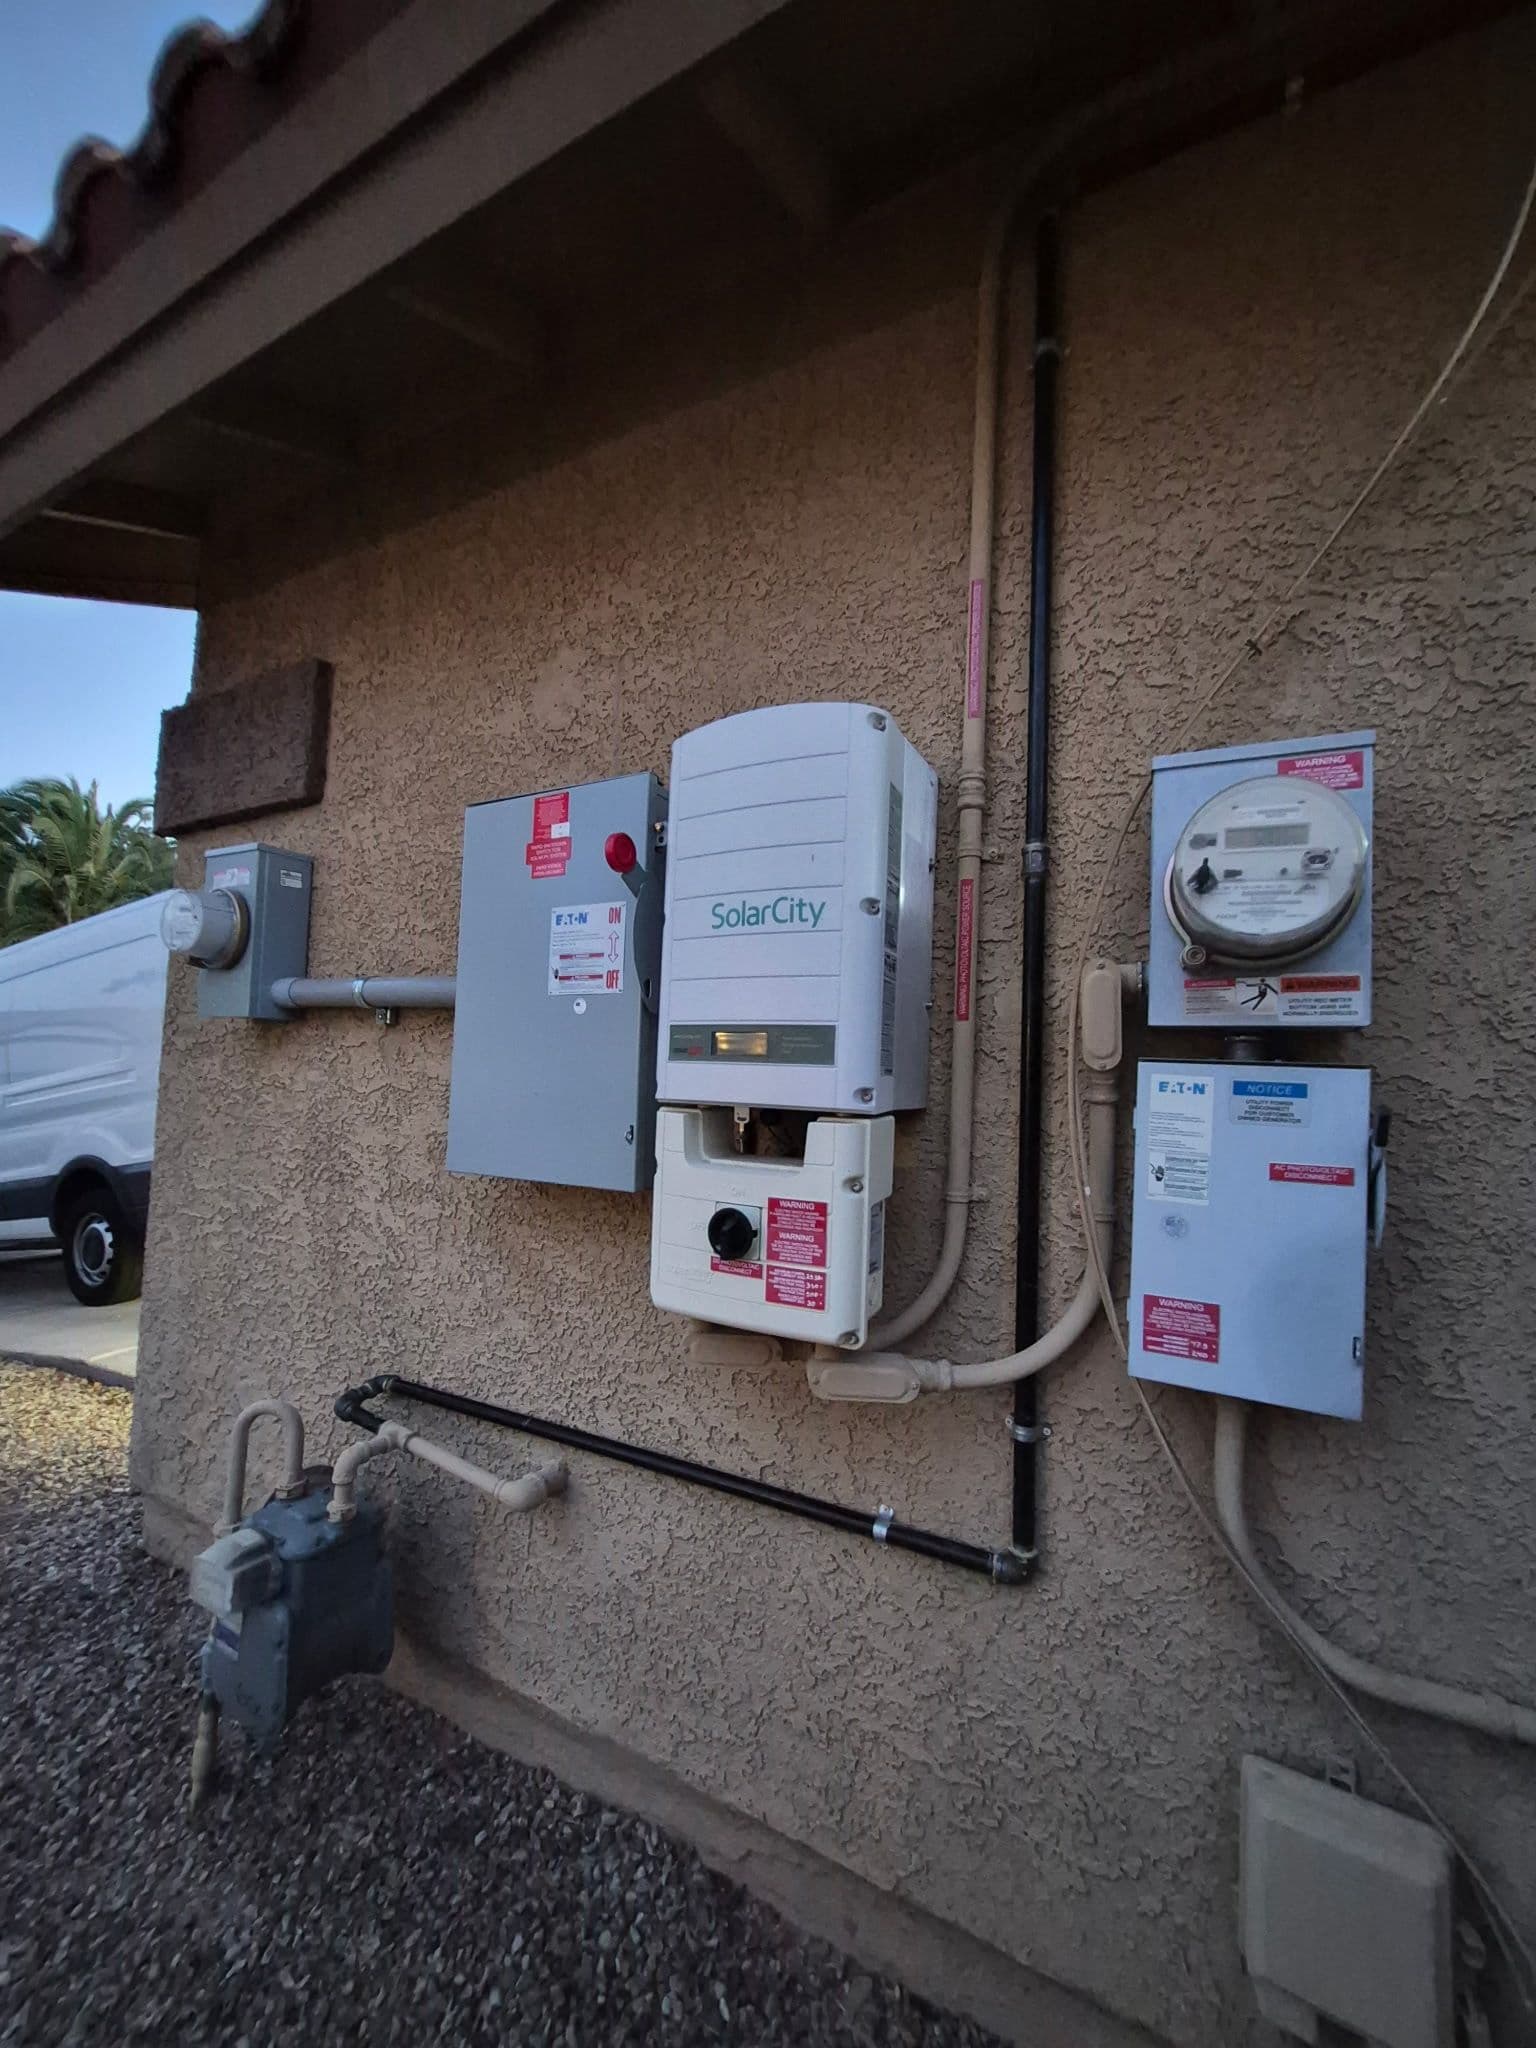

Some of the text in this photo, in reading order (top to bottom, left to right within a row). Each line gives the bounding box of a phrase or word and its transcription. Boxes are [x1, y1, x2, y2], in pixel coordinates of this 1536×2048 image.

[1294, 755, 1347, 768] WARNING
[608, 906, 622, 924] ON
[712, 897, 826, 929] SolarCity
[606, 969, 620, 989] OFF
[1247, 1083, 1293, 1095] NOTICE
[779, 1199, 815, 1211] WARNING
[779, 1231, 815, 1243] WARNING
[1158, 1298, 1205, 1312] WARNING
